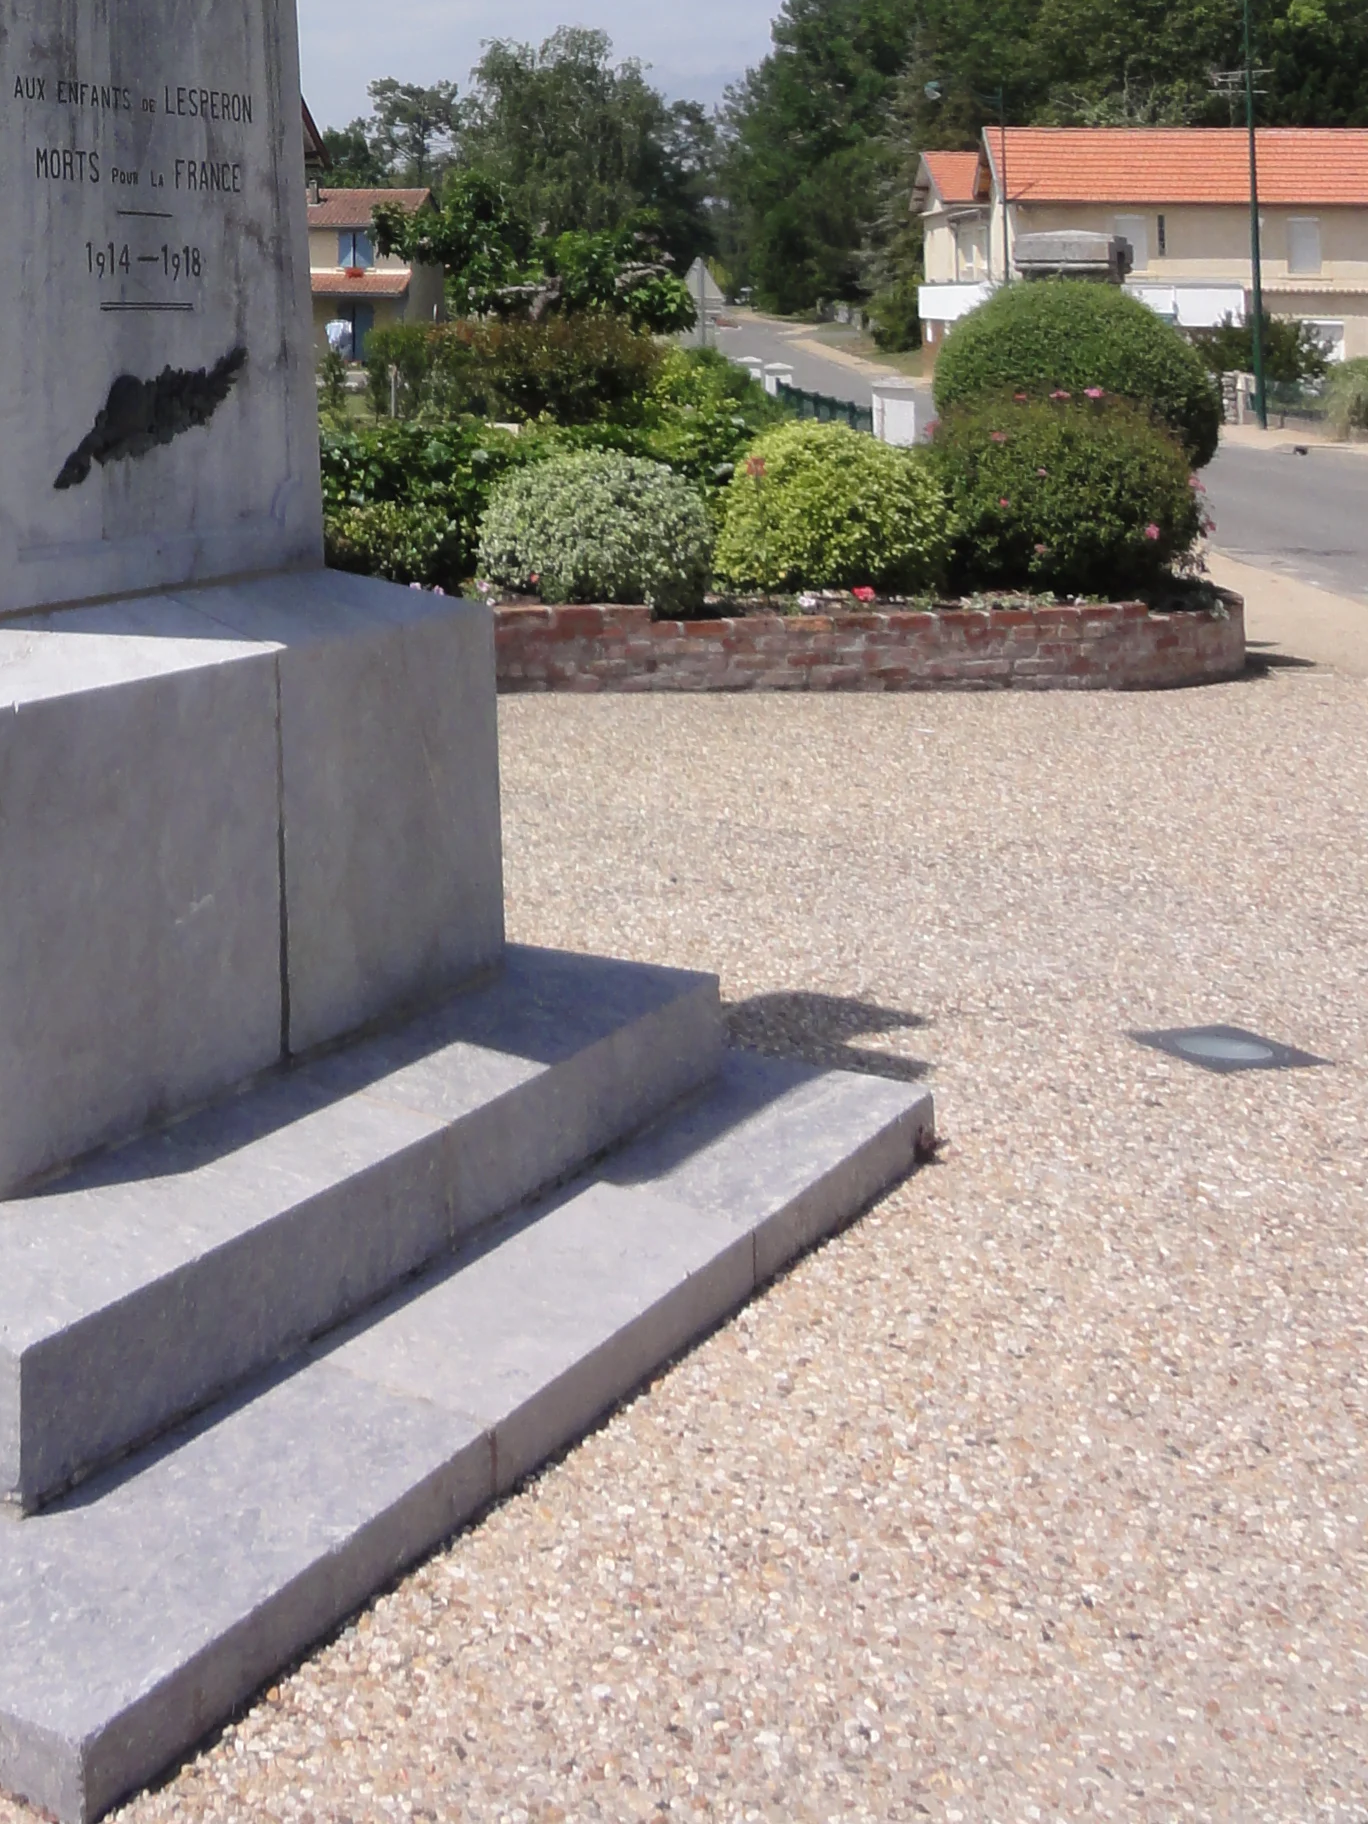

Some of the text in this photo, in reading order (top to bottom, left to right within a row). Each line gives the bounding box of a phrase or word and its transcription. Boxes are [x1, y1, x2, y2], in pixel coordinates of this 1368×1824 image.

[14, 75, 253, 124] AUX ENFANTS DE LESPERON
[35, 146, 241, 193] MORTS POUR LA FRANCE
